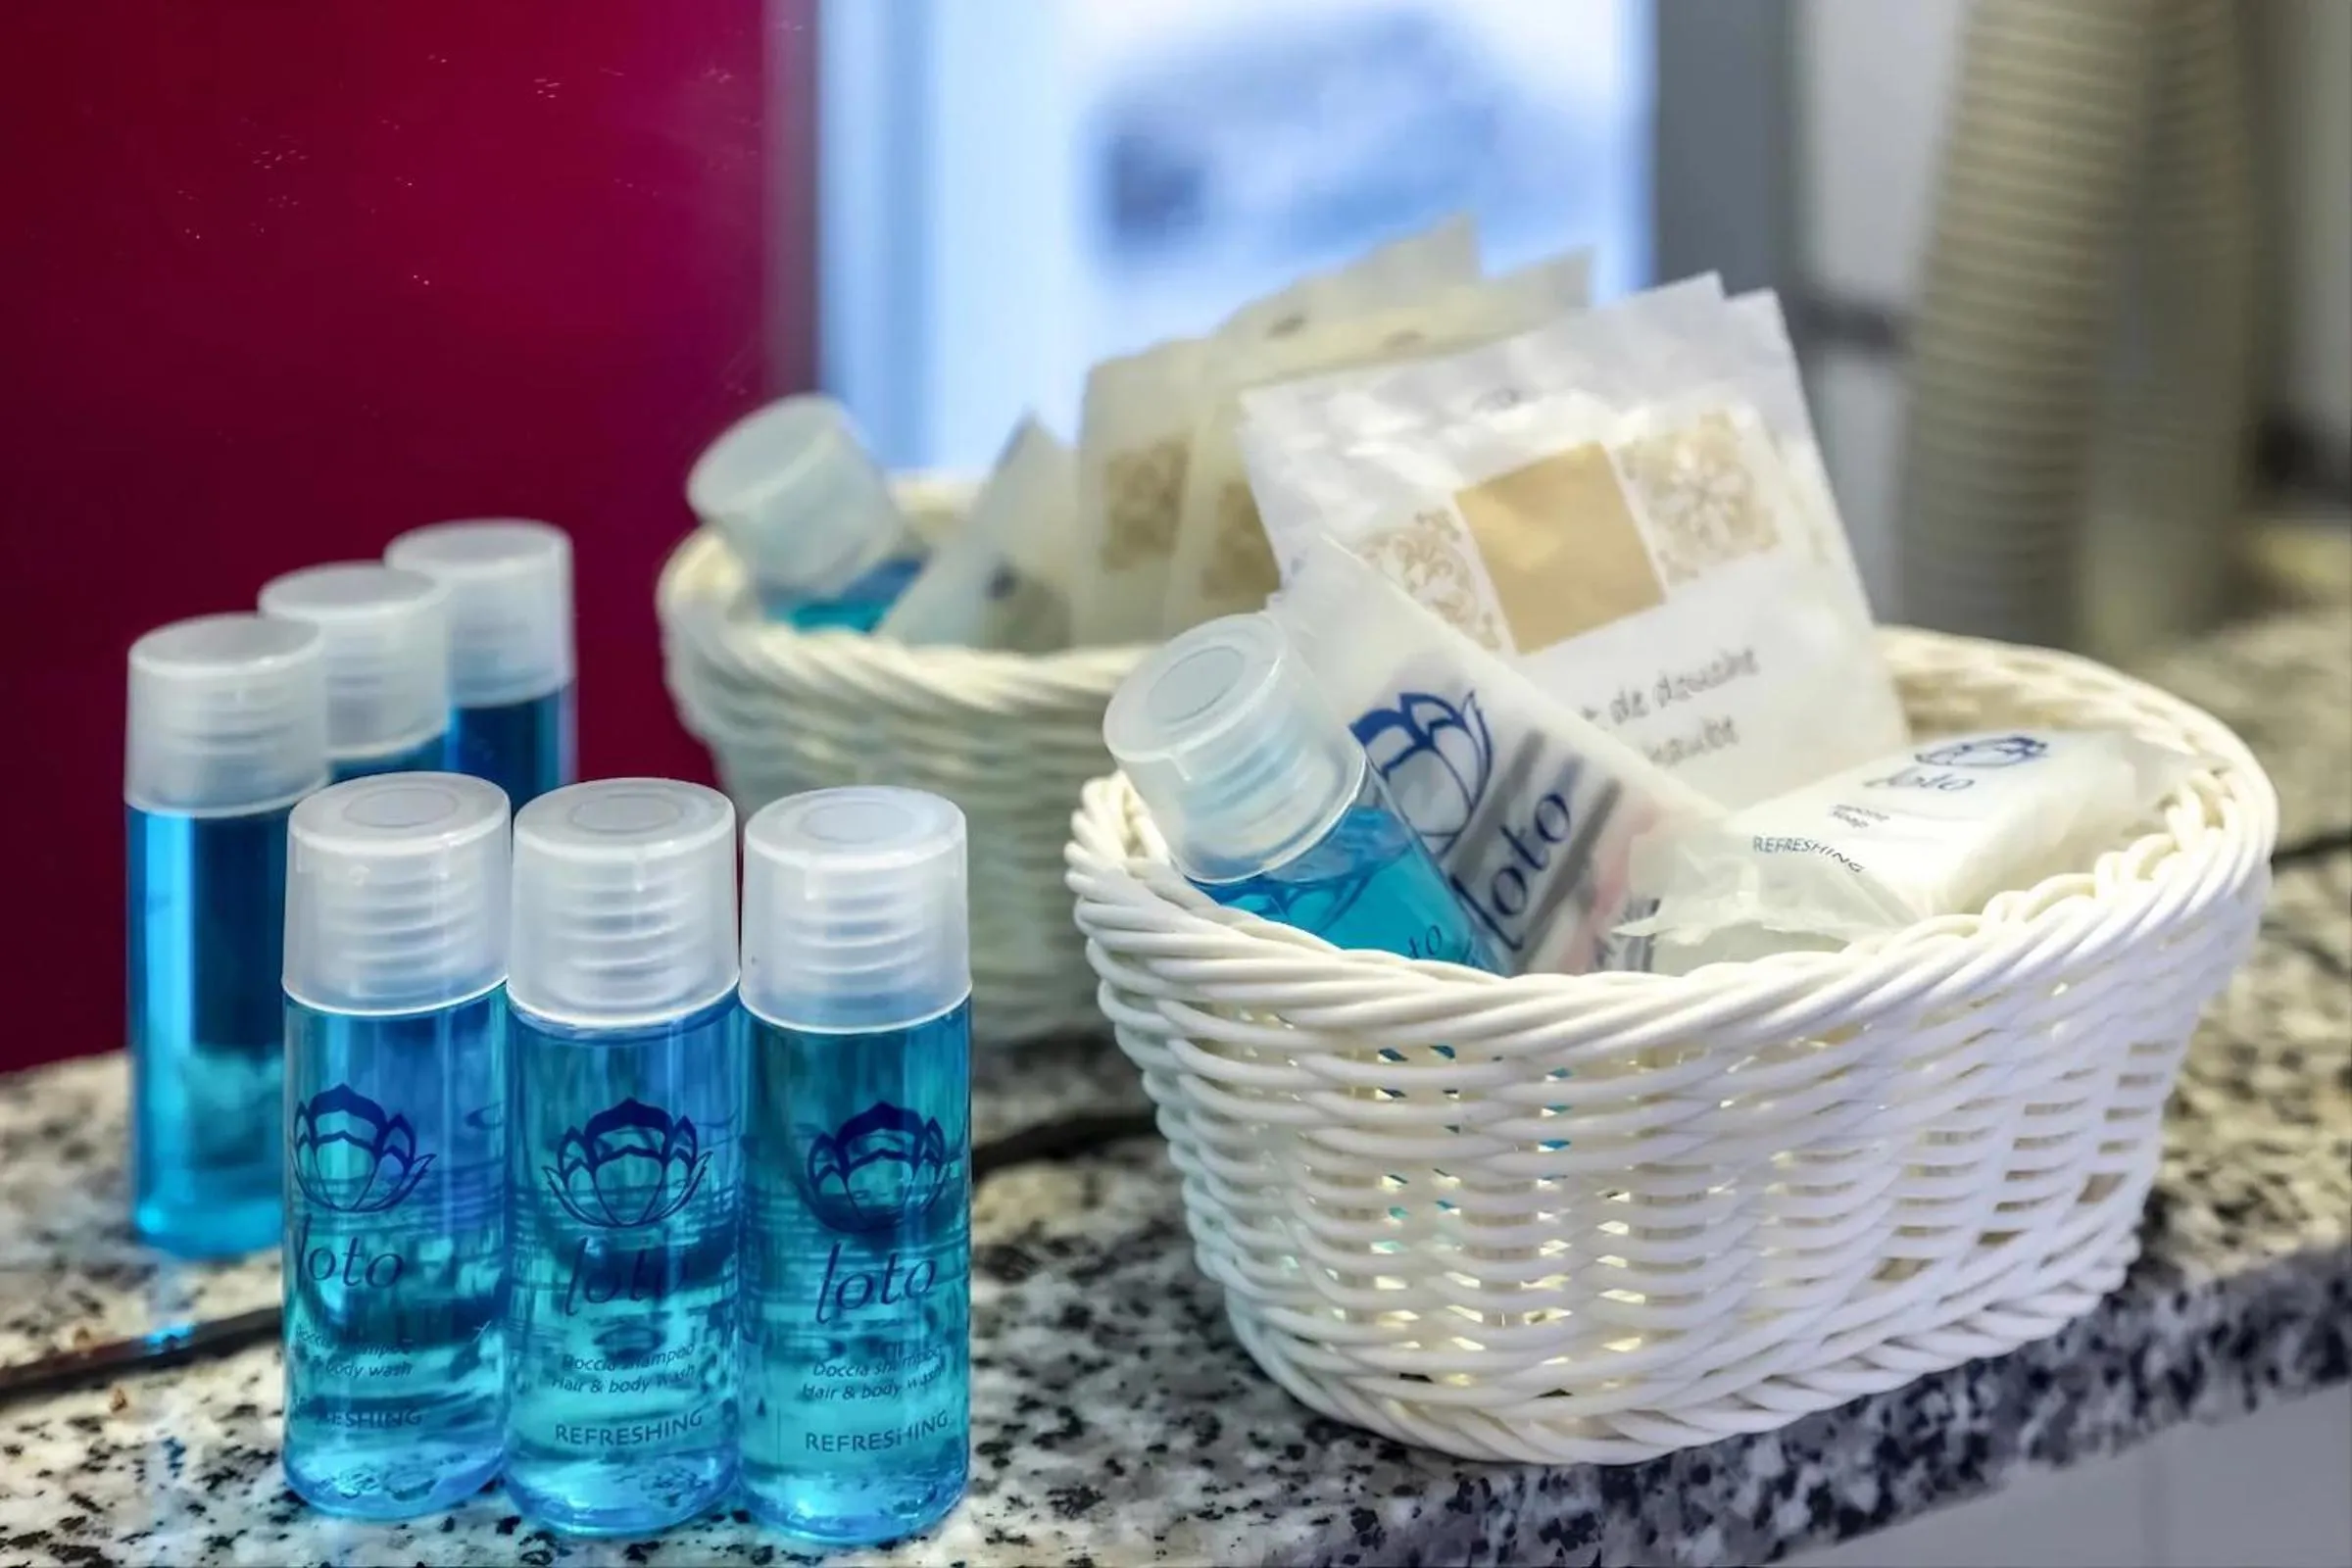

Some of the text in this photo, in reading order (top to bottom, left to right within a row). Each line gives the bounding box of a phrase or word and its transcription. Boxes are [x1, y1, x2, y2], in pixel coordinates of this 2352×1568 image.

[1448, 792, 1572, 952] loto
[1752, 835, 1867, 873] REFRESHING
[815, 1240, 938, 1326] loto
[589, 1378, 604, 1394] &
[609, 1375, 651, 1396] body
[812, 1356, 870, 1378] Doccia
[802, 1382, 836, 1401] Hair
[841, 1385, 857, 1401] &
[860, 1378, 904, 1399] body
[555, 1408, 704, 1447] REFRESHING
[805, 1409, 949, 1453] REFRESHING
